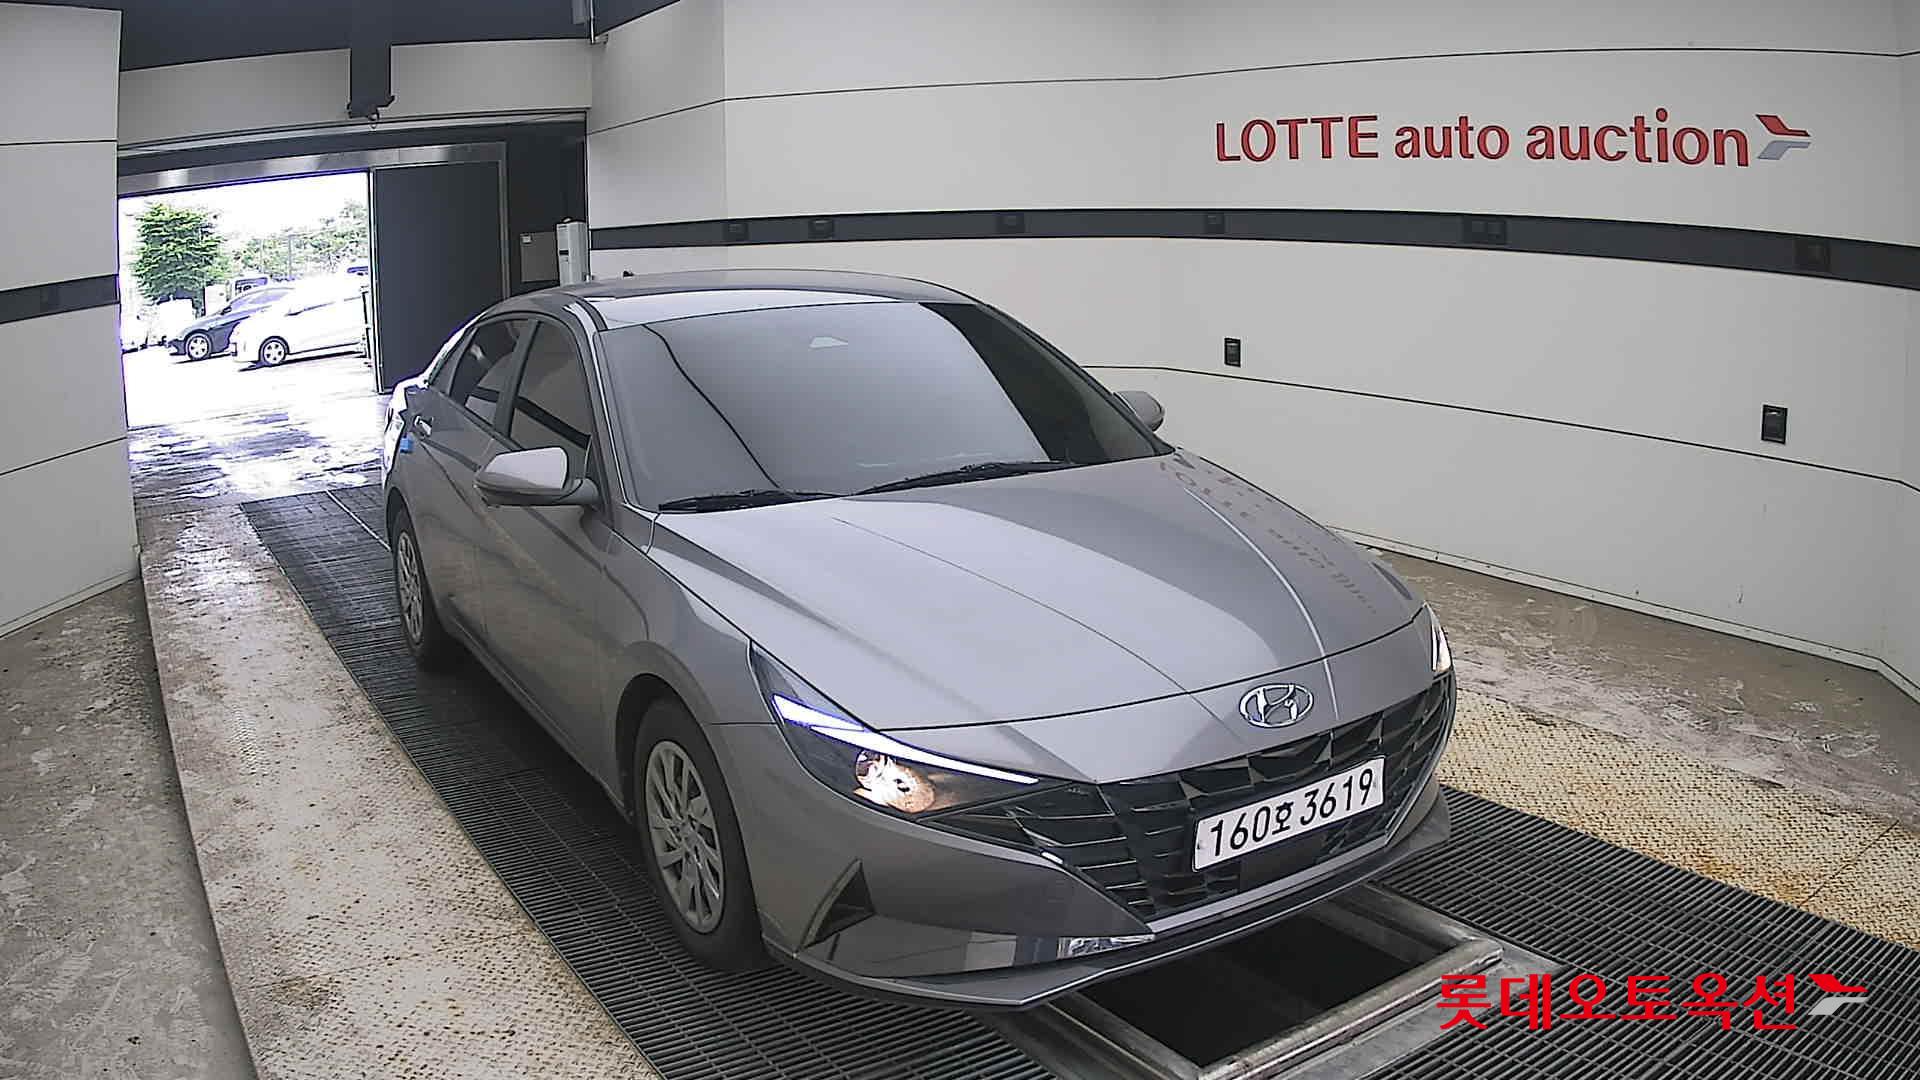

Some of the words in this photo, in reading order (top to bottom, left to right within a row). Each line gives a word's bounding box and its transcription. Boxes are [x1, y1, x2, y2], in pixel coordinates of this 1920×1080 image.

[1215, 115, 1379, 162] LOTTE
[1394, 116, 1512, 161] auto
[1526, 108, 1751, 167] auction
[1210, 801, 1294, 857] 160호
[1300, 768, 1373, 826] 3619
